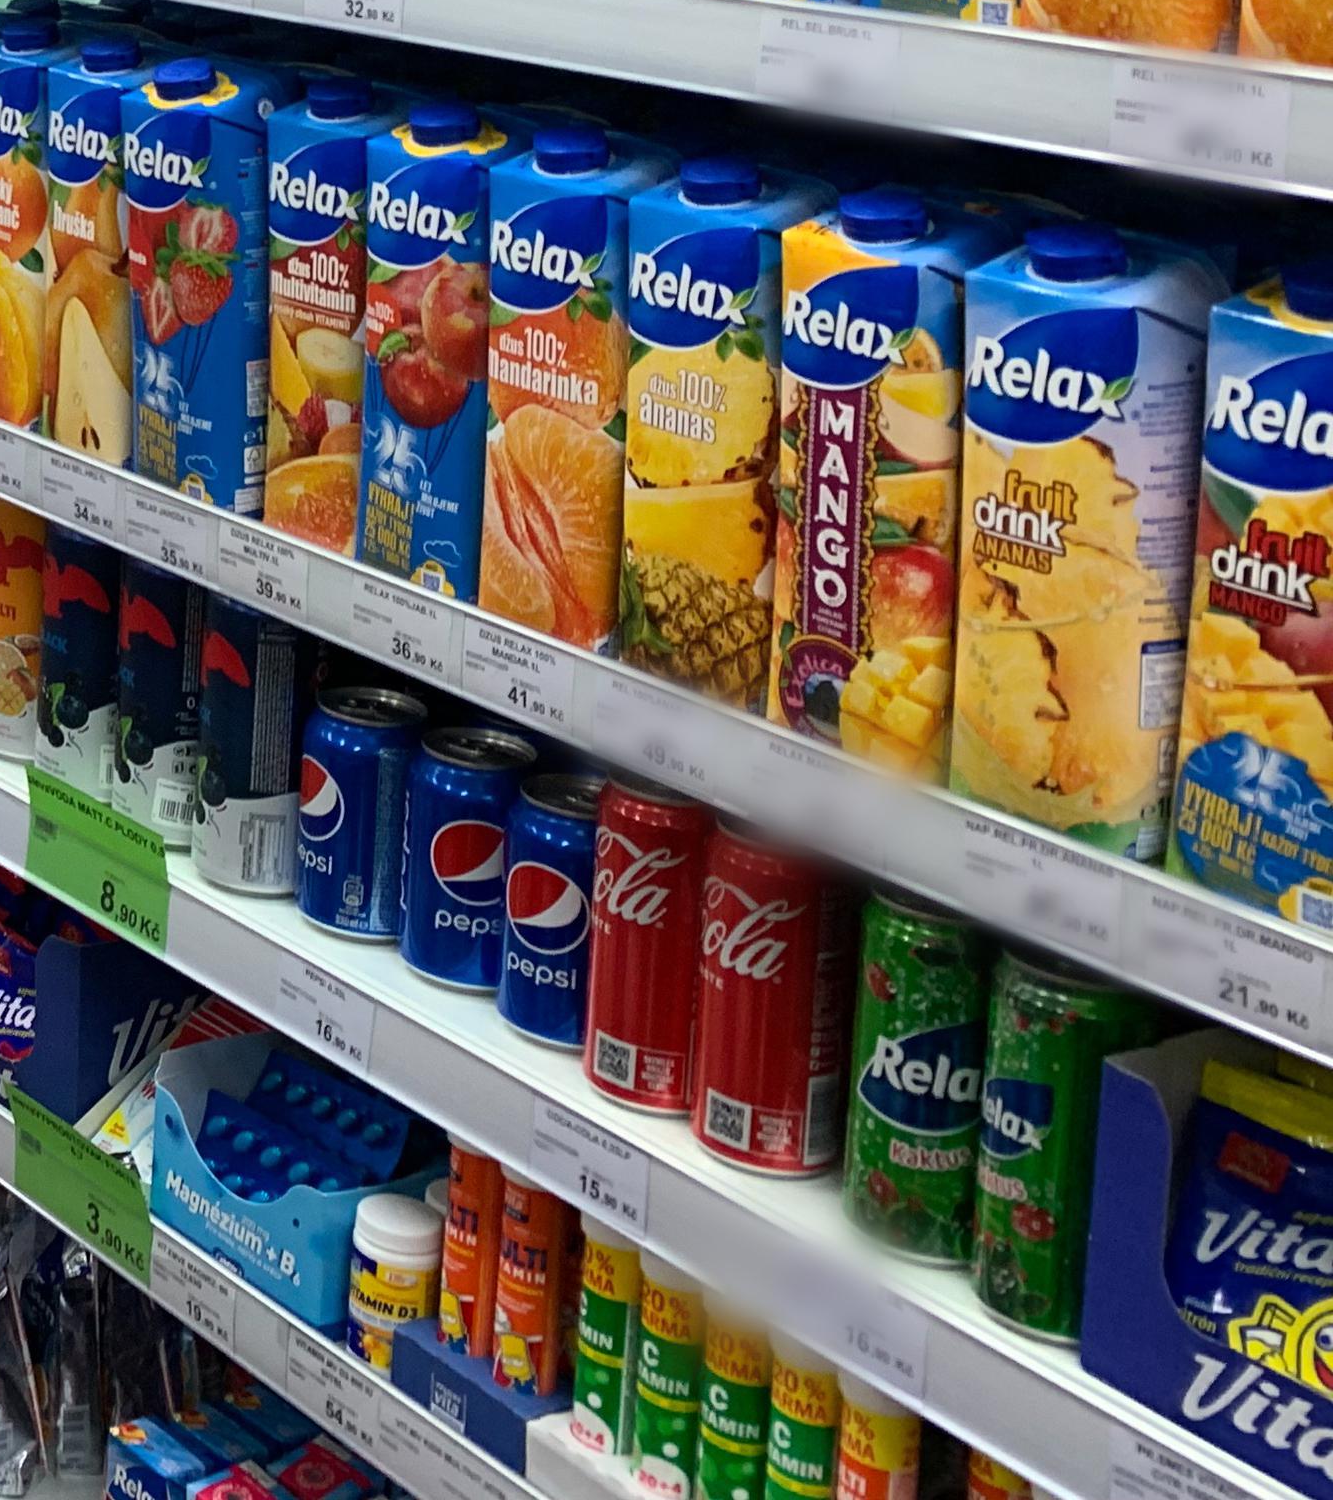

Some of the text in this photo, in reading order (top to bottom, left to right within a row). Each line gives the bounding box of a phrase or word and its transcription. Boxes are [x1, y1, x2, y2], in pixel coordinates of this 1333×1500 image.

[48, 109, 120, 165] Relax
[124, 130, 206, 191] Relax
[269, 161, 360, 222] Relax
[367, 180, 469, 247] Relax
[52, 199, 96, 244] hruška
[287, 251, 351, 292] džus 100%
[490, 219, 597, 289] Relax
[271, 269, 358, 314] multivitamin
[631, 252, 746, 327] Relax
[498, 326, 569, 370] džus 100%
[784, 288, 907, 367] Relax
[488, 353, 599, 406] mandarinka
[648, 369, 728, 413] džus 100%
[971, 336, 1125, 421] Relax
[639, 391, 716, 445] ananas
[1210, 376, 1333, 459] Rela
[813, 397, 855, 610] MANGO
[972, 494, 1066, 553] drink
[1004, 470, 1079, 525] fruit
[972, 532, 1053, 575] ANANAS
[1246, 520, 1332, 575] fruit
[1210, 580, 1288, 626] MANGO
[1211, 546, 1316, 611] drink
[502, 635, 531, 656] RELAX
[1184, 779, 1264, 844] VYHRAJ!
[139, 913, 162, 943] Kč
[506, 949, 578, 993] pepsi
[1287, 1008, 1311, 1031] Kč
[869, 1034, 982, 1103] Rela
[982, 1090, 1042, 1152] elax
[888, 1136, 974, 1171] Kaktus
[165, 1169, 263, 1256] Magnézium
[123, 1244, 146, 1273] Kč
[1196, 1206, 1333, 1291] Vita
[397, 1305, 419, 1320] D3
